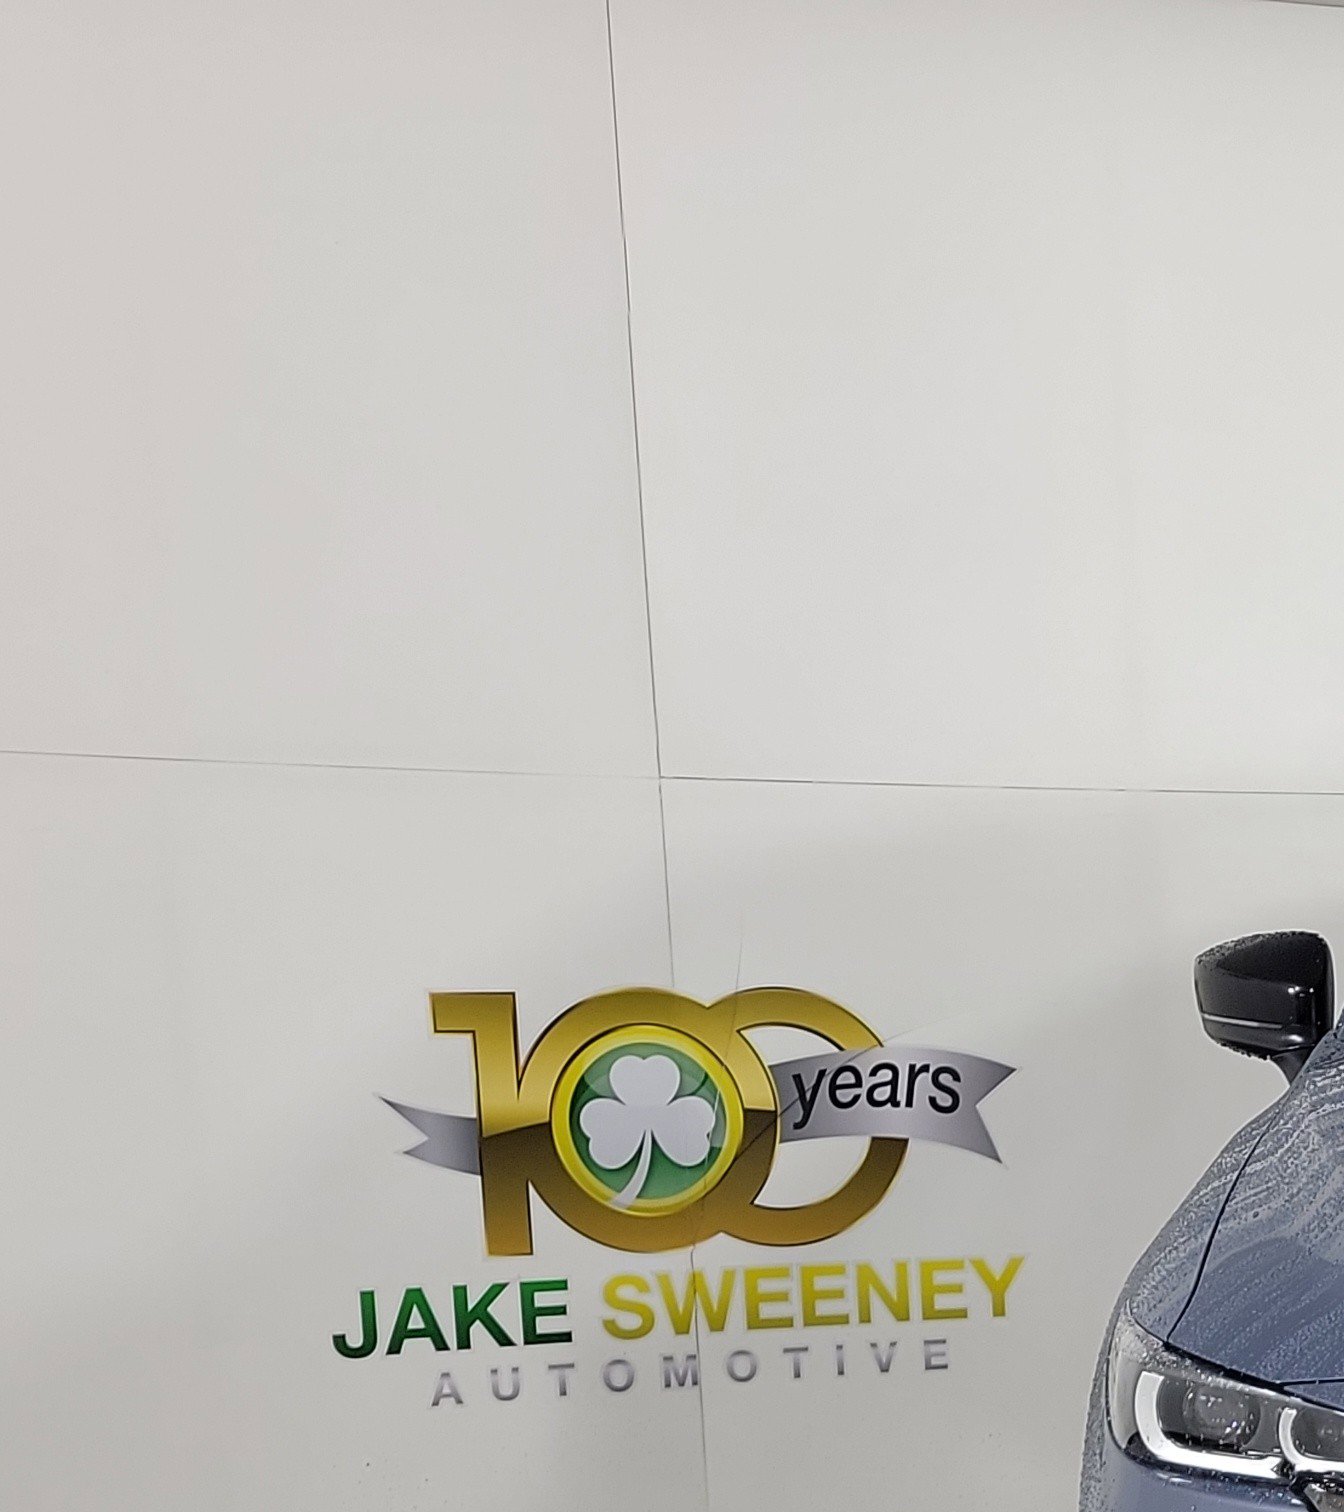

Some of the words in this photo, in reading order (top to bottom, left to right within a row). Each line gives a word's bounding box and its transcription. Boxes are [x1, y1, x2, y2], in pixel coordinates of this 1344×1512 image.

[429, 986, 910, 1257] 100
[792, 1060, 962, 1130] years
[332, 1279, 574, 1360] JAKE
[601, 1255, 1027, 1341] SWEENEY
[431, 1338, 949, 1407] AUTOMOTIVE
